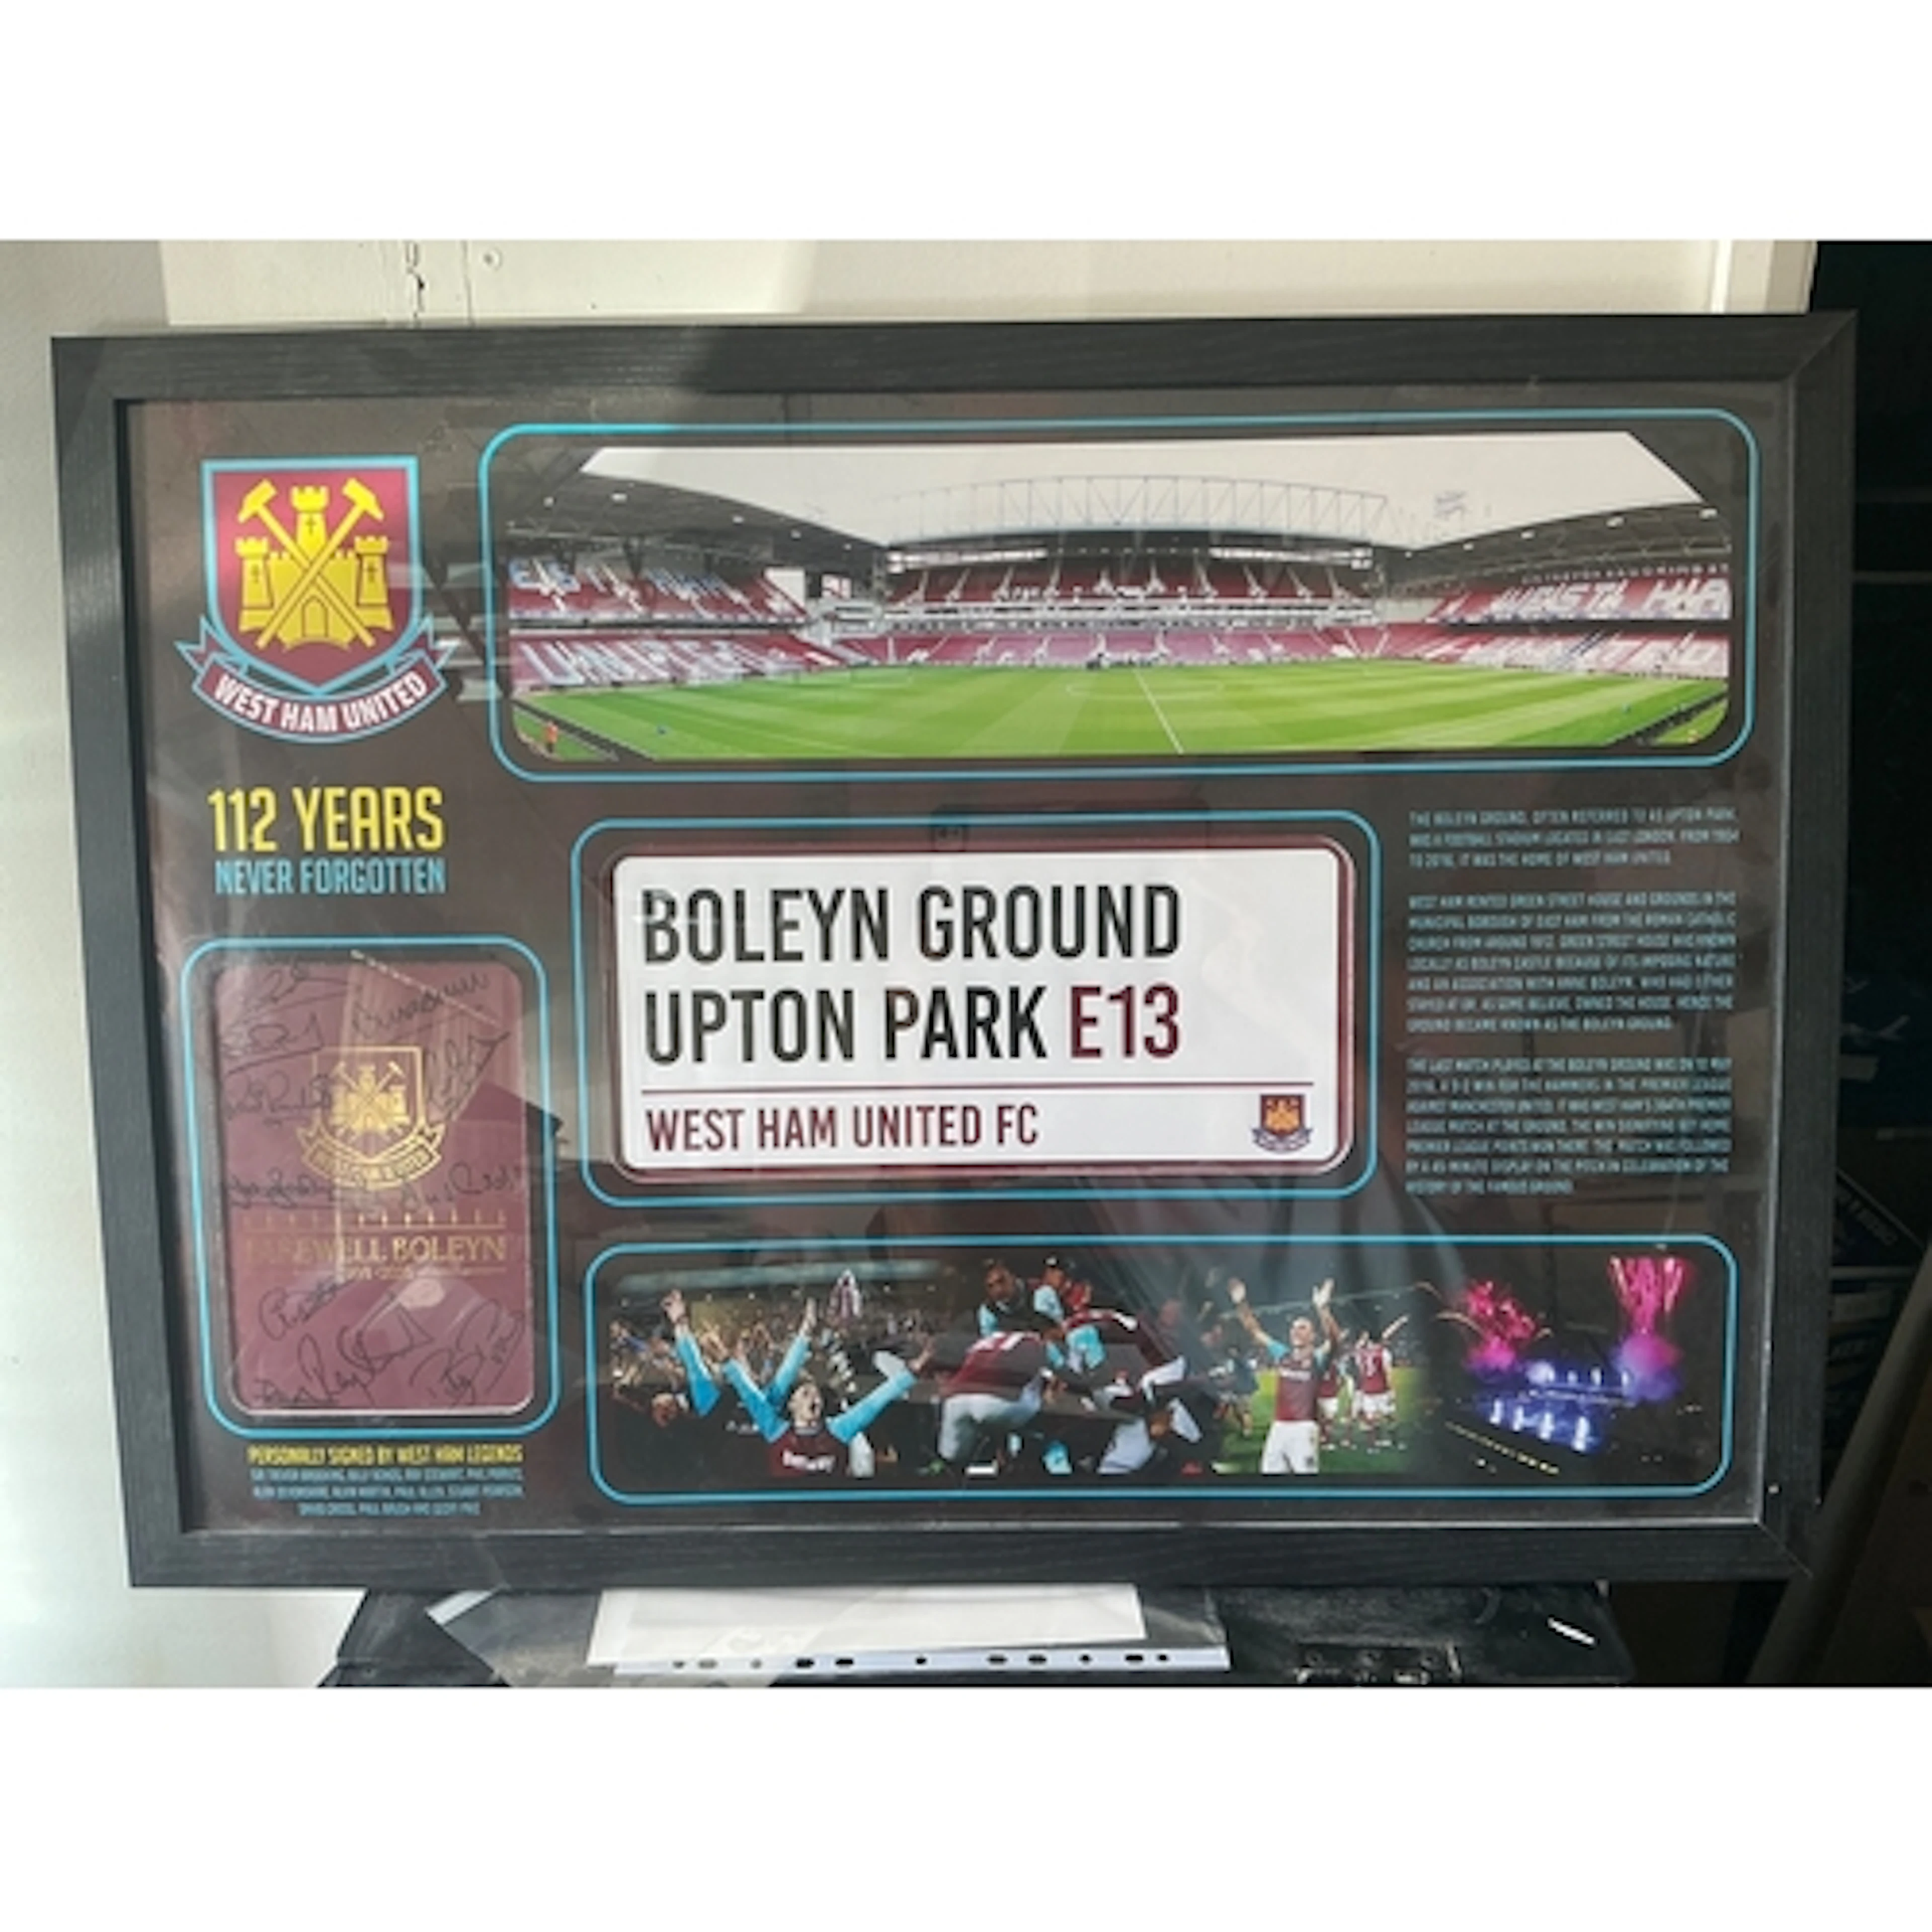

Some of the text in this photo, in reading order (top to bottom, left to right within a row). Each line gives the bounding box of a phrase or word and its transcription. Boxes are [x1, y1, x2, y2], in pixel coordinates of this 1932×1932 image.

[214, 669, 428, 733] WEST HAM UNITED
[207, 785, 444, 853] 112 YEARS
[214, 857, 446, 896] NEVER FORGOTTEN
[642, 884, 1180, 964] BOLEYN GROUND
[645, 984, 1180, 1064] UPTON PARK E13
[647, 1103, 1038, 1152] WEST HAM UNITED FC
[391, 1234, 505, 1262] BOLEYN
